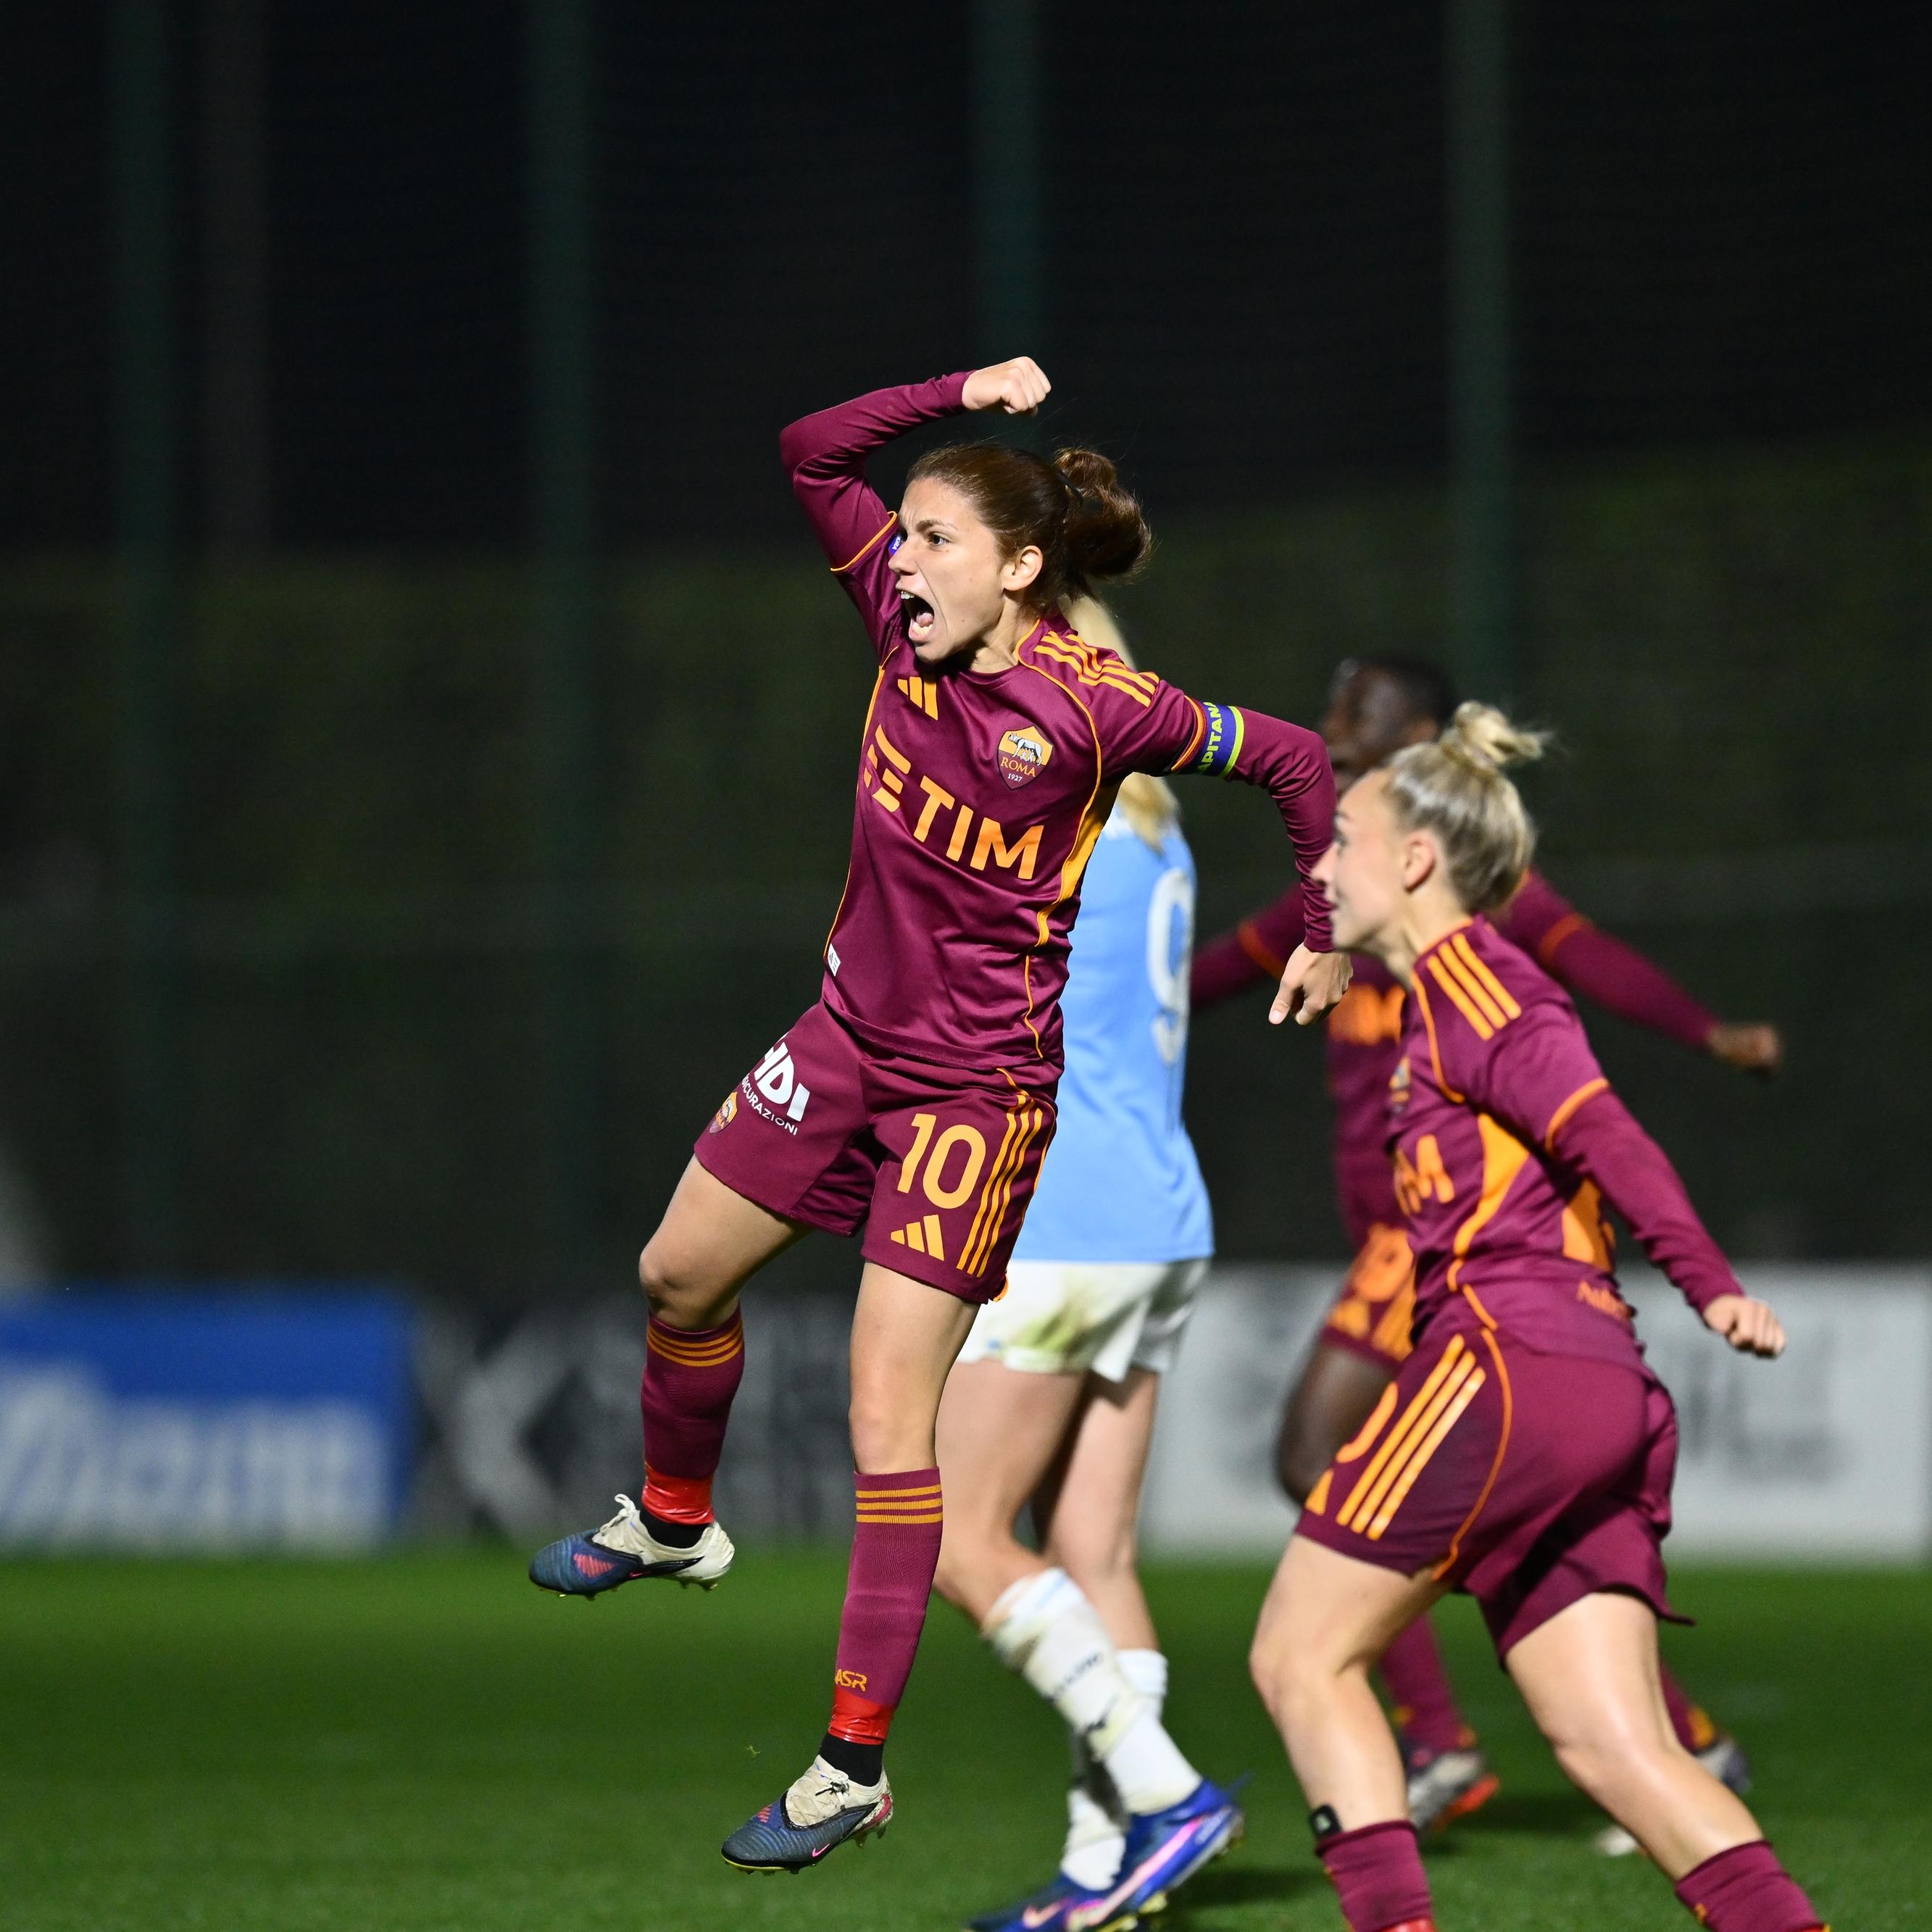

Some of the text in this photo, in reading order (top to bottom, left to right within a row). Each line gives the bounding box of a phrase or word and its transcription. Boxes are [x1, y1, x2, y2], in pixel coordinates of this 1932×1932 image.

[1001, 757, 1036, 778] ROMA
[1007, 773, 1023, 782] 1927
[913, 775, 1044, 880] TIM
[897, 1113, 986, 1209] 10
[835, 1669, 867, 1692] ASR
